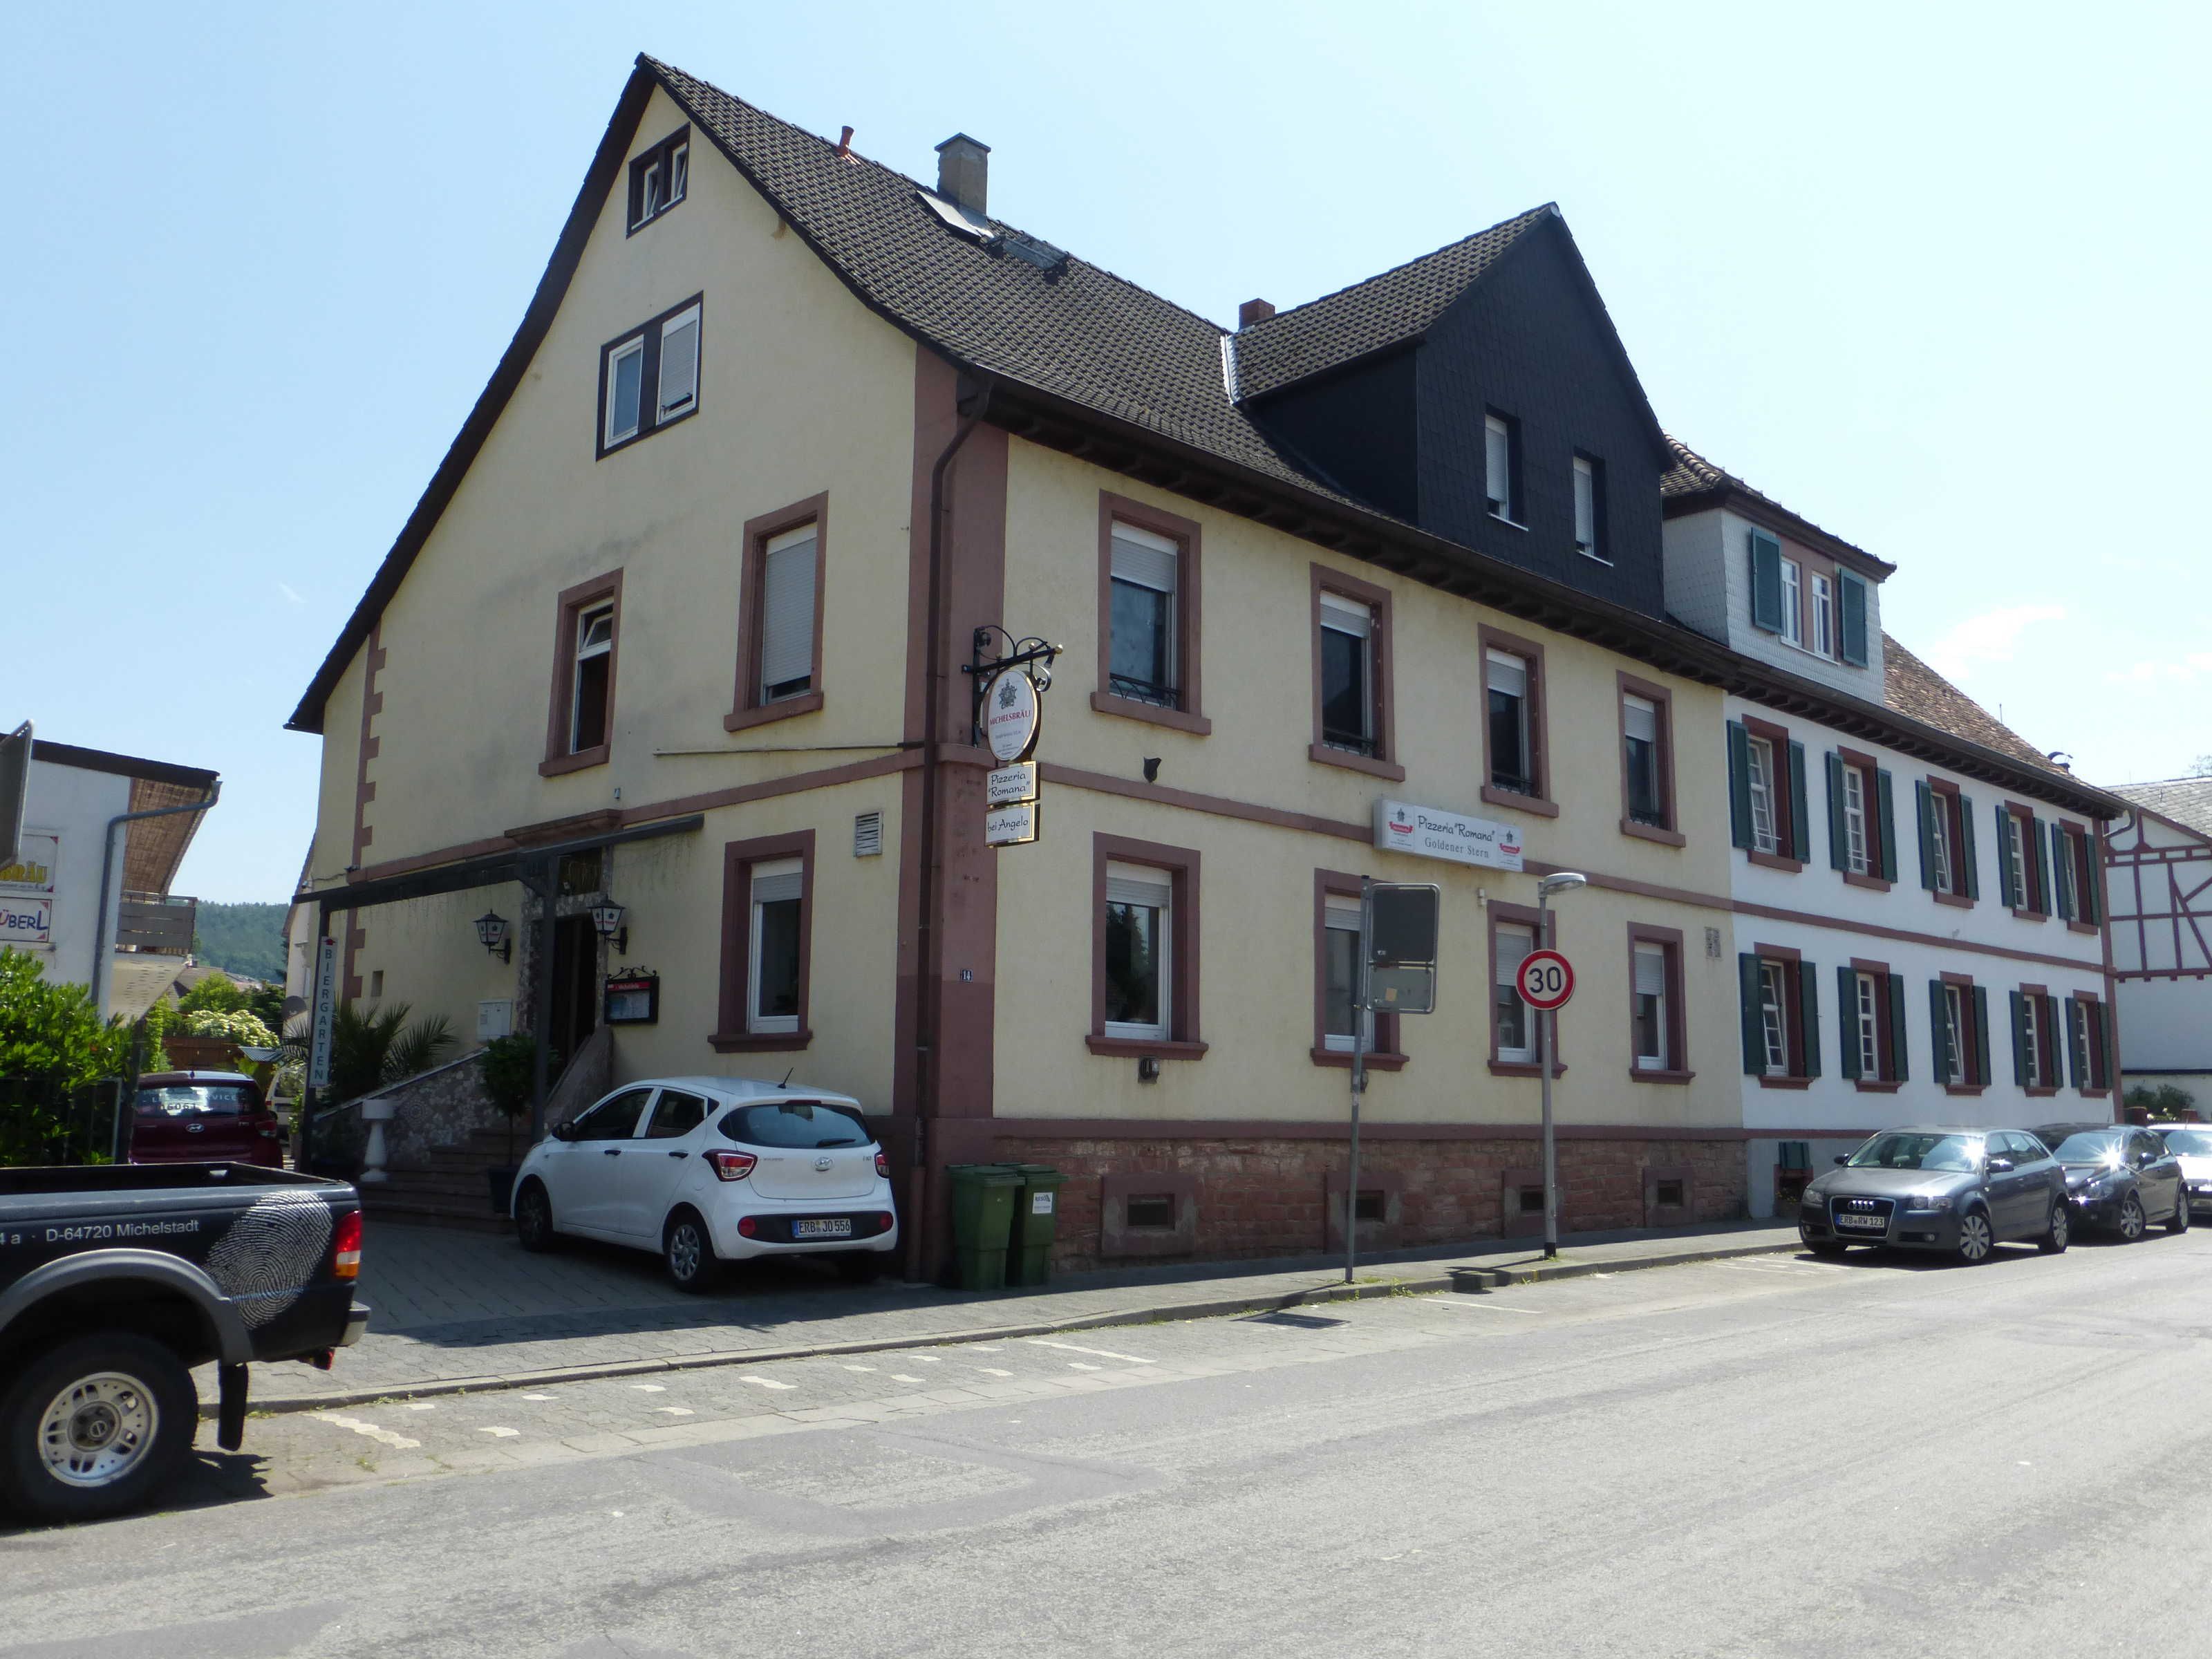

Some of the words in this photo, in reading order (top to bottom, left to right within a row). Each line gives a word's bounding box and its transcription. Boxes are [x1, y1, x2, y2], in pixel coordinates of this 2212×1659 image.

[991, 771, 1026, 785] Pizzeria
[988, 821, 997, 832] bei
[997, 815, 1029, 831] Angelo
[1425, 837, 1463, 854] Goldener
[1468, 845, 1489, 858] Stern
[1528, 966, 1562, 993] 30
[315, 949, 332, 1073] BIERGARTEN
[46, 1224, 112, 1242] D-64720
[116, 1219, 200, 1237] Michelstadt
[799, 1221, 816, 1233] ERB
[1869, 1217, 1884, 1226] 123
